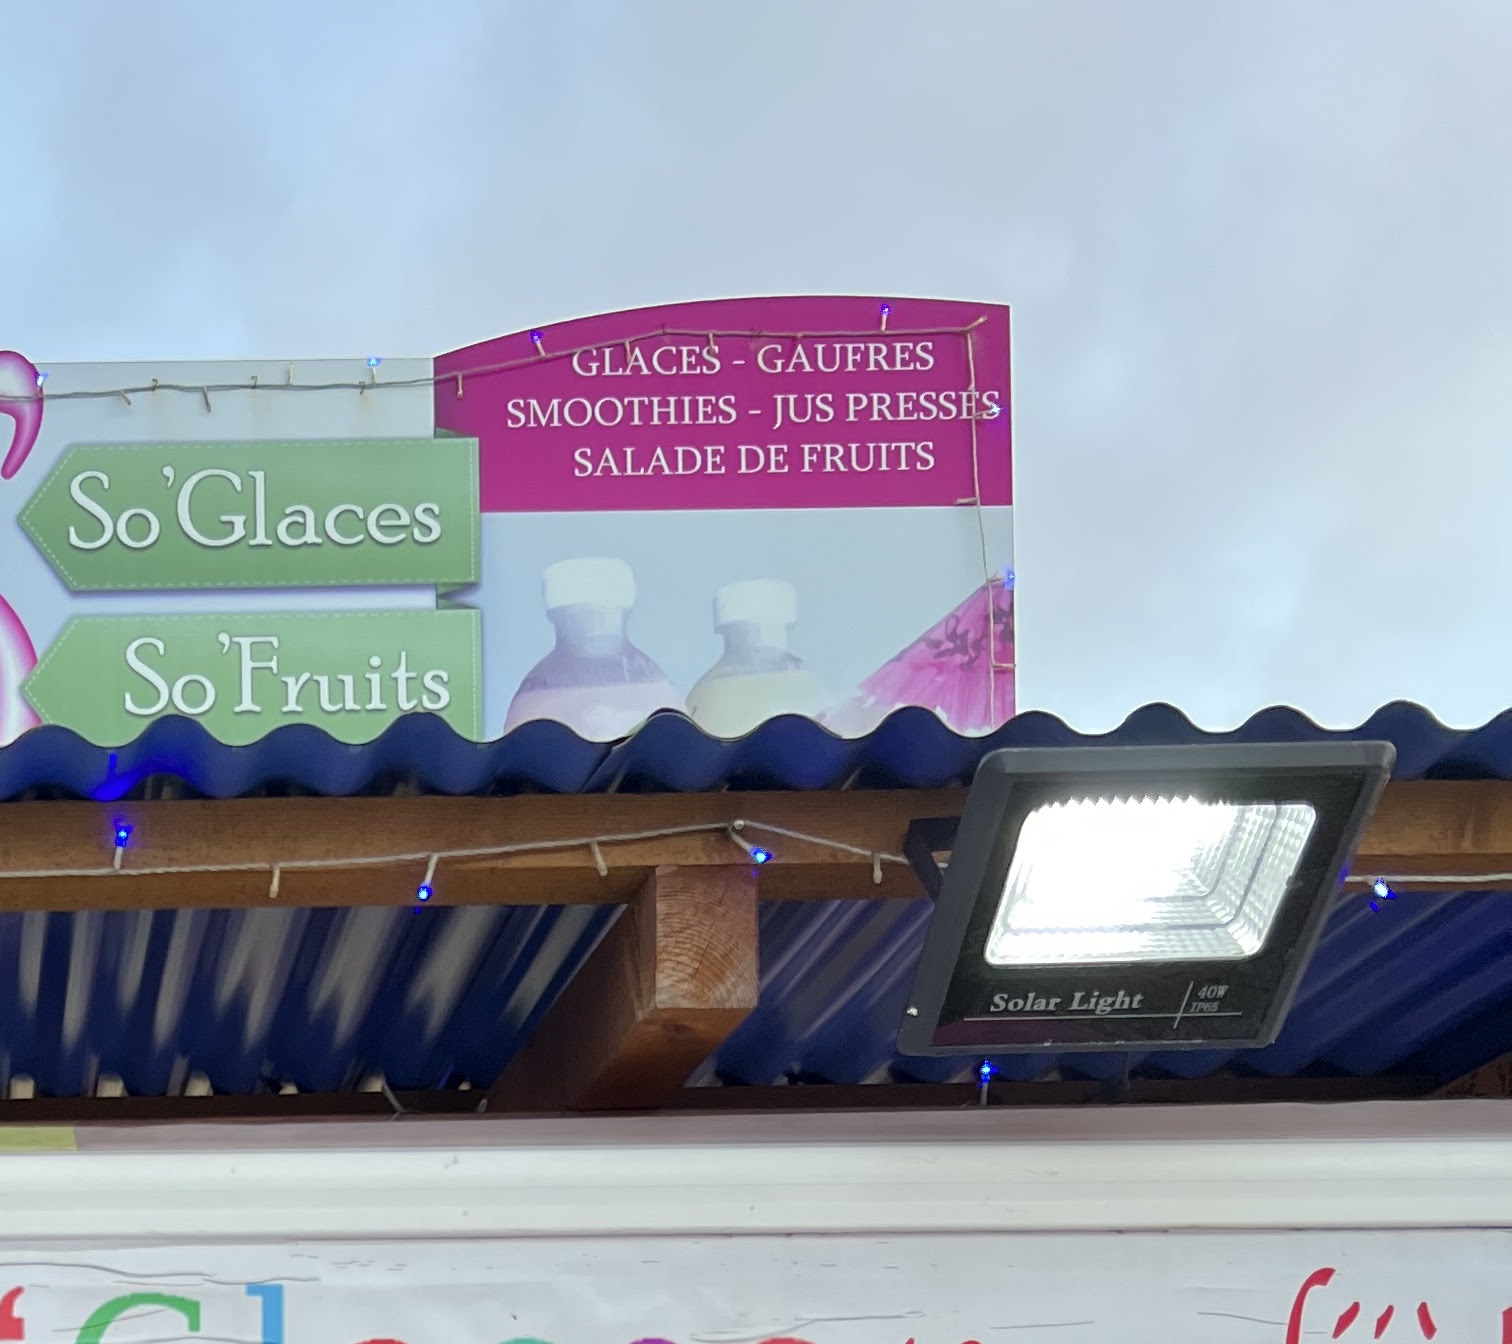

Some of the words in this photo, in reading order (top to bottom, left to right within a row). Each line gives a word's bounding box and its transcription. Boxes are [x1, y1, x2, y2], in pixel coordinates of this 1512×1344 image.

[572, 346, 720, 378] GLACES
[758, 342, 934, 373] GAUFRES
[508, 396, 736, 427] SMOOTHIES
[773, 394, 834, 429] JUS
[575, 446, 725, 476] SALADE
[738, 445, 788, 473] DE
[801, 442, 934, 472] FRUITS
[990, 992, 1061, 1012] Solar
[1068, 991, 1143, 1015] Light
[1198, 985, 1228, 1000] 40W
[1190, 1002, 1219, 1013] IP65
